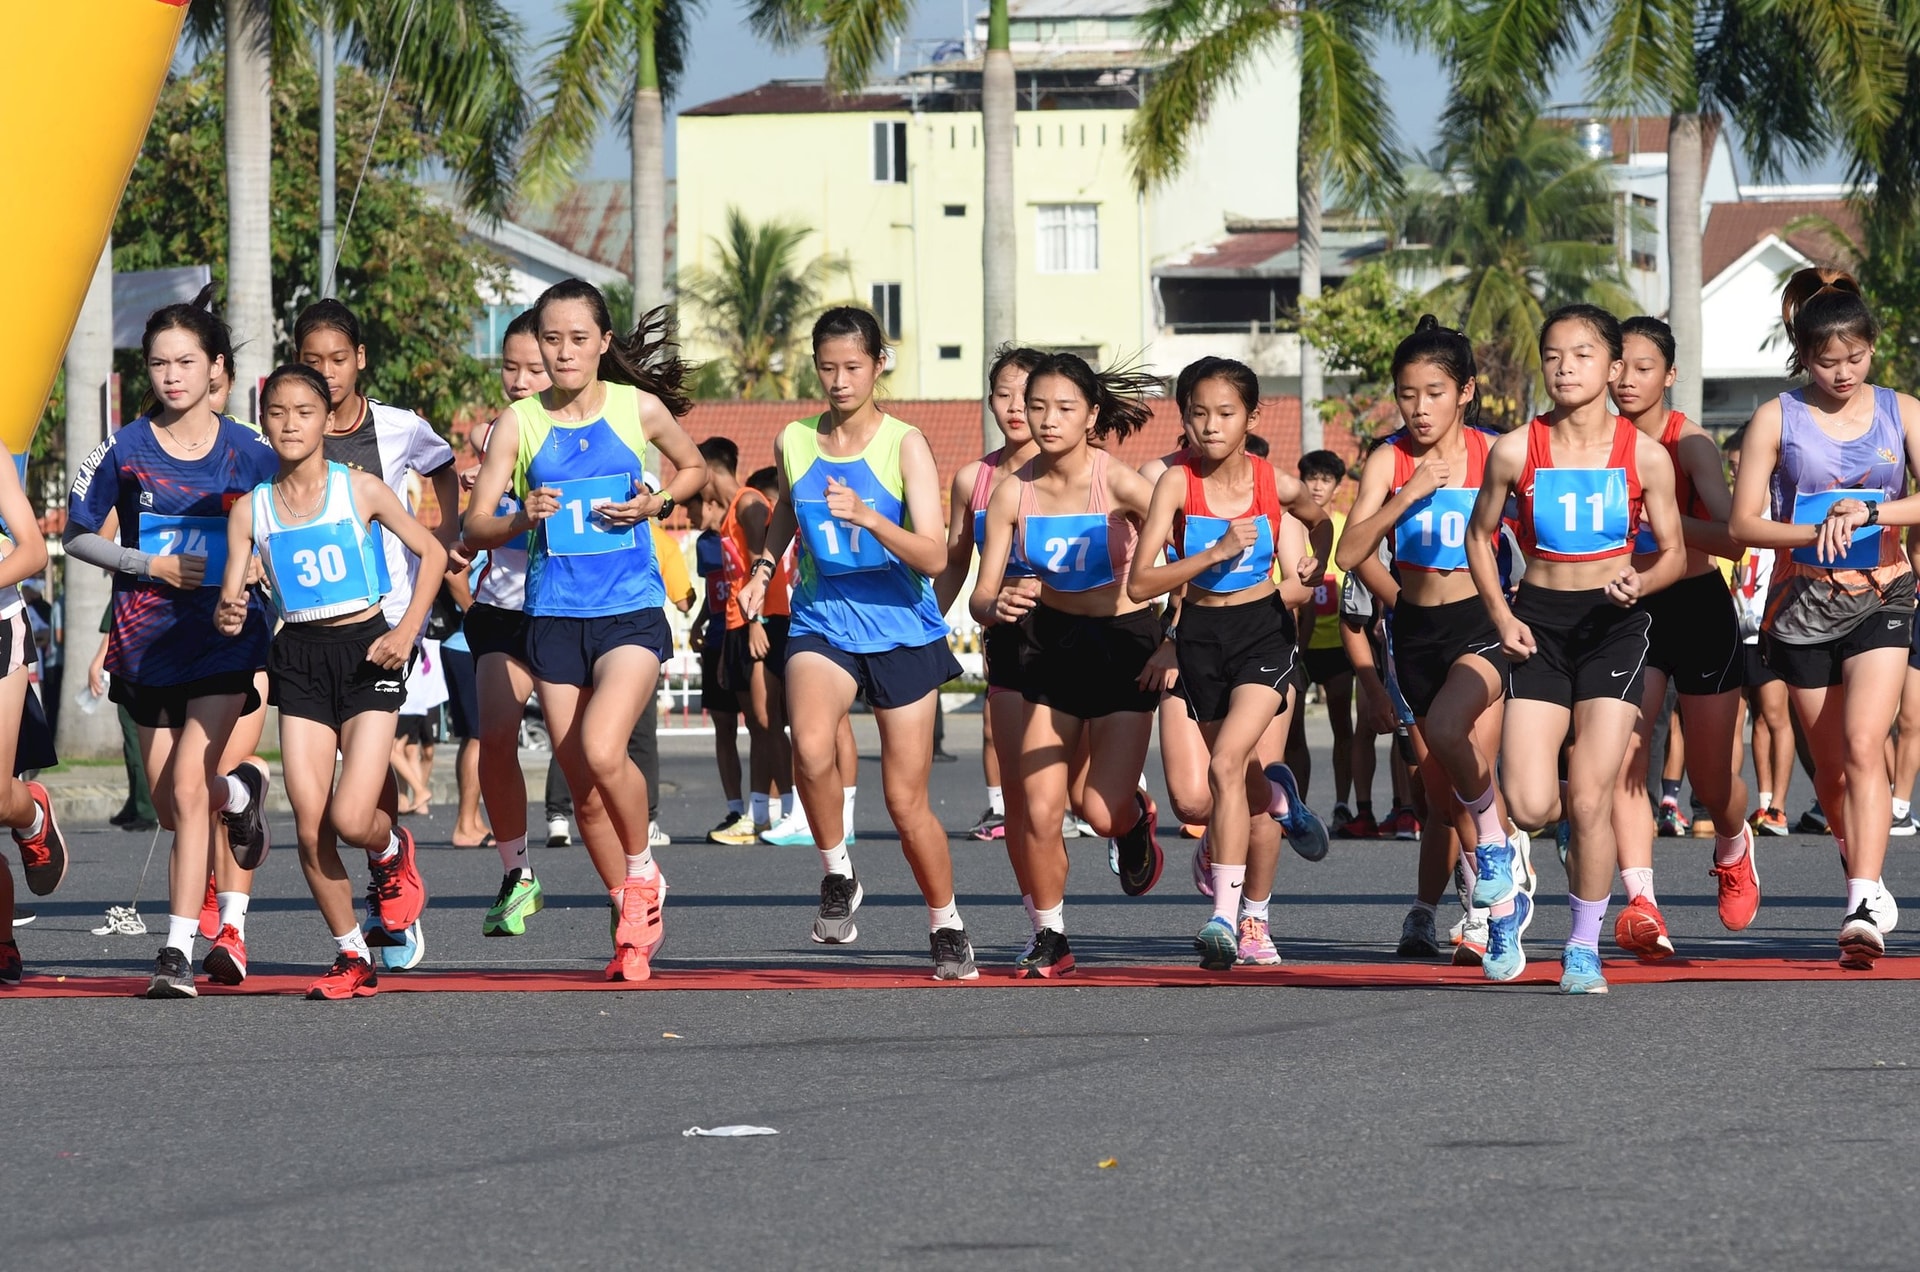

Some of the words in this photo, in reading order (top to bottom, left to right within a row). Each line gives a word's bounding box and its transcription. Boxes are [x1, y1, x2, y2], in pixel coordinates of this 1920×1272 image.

[71, 434, 117, 502] JOGARBOLA
[1415, 510, 1465, 548] 10
[1558, 492, 1604, 532] 11
[159, 528, 208, 557] 24
[818, 519, 861, 555] 17
[1045, 536, 1090, 573] 27
[293, 544, 347, 588] 30
